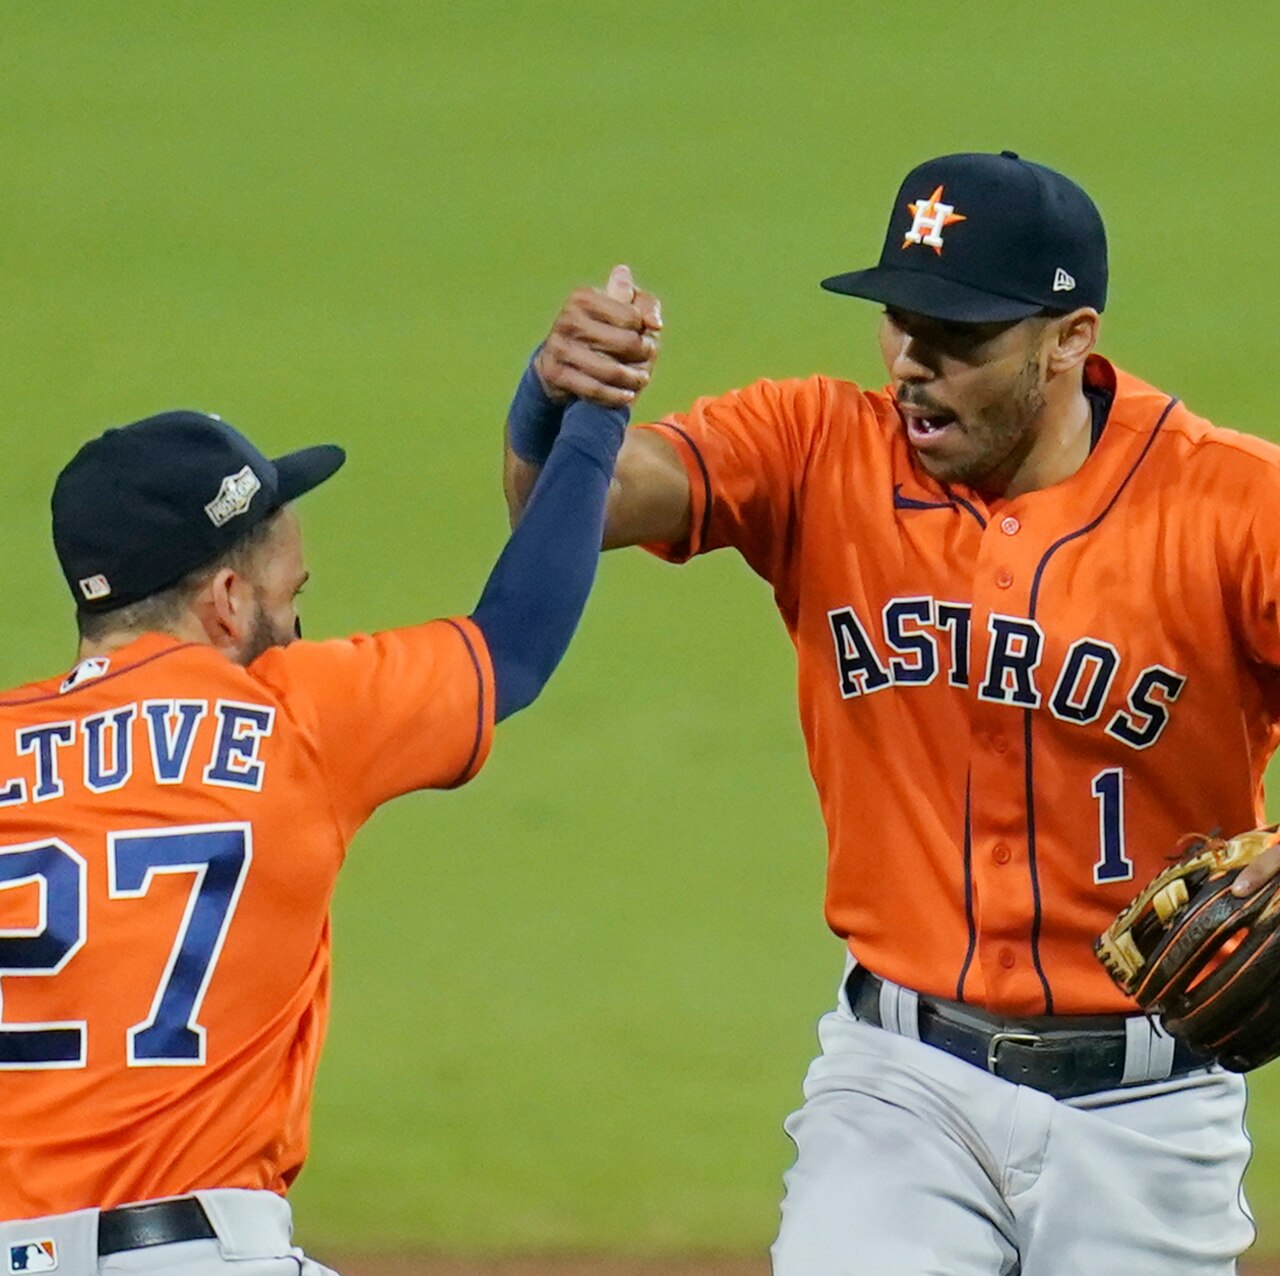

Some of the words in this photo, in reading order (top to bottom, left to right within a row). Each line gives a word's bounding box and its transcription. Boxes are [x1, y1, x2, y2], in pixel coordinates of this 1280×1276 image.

[905, 200, 954, 248] H
[827, 596, 1187, 750] ASTROS
[1092, 767, 1134, 885] 1
